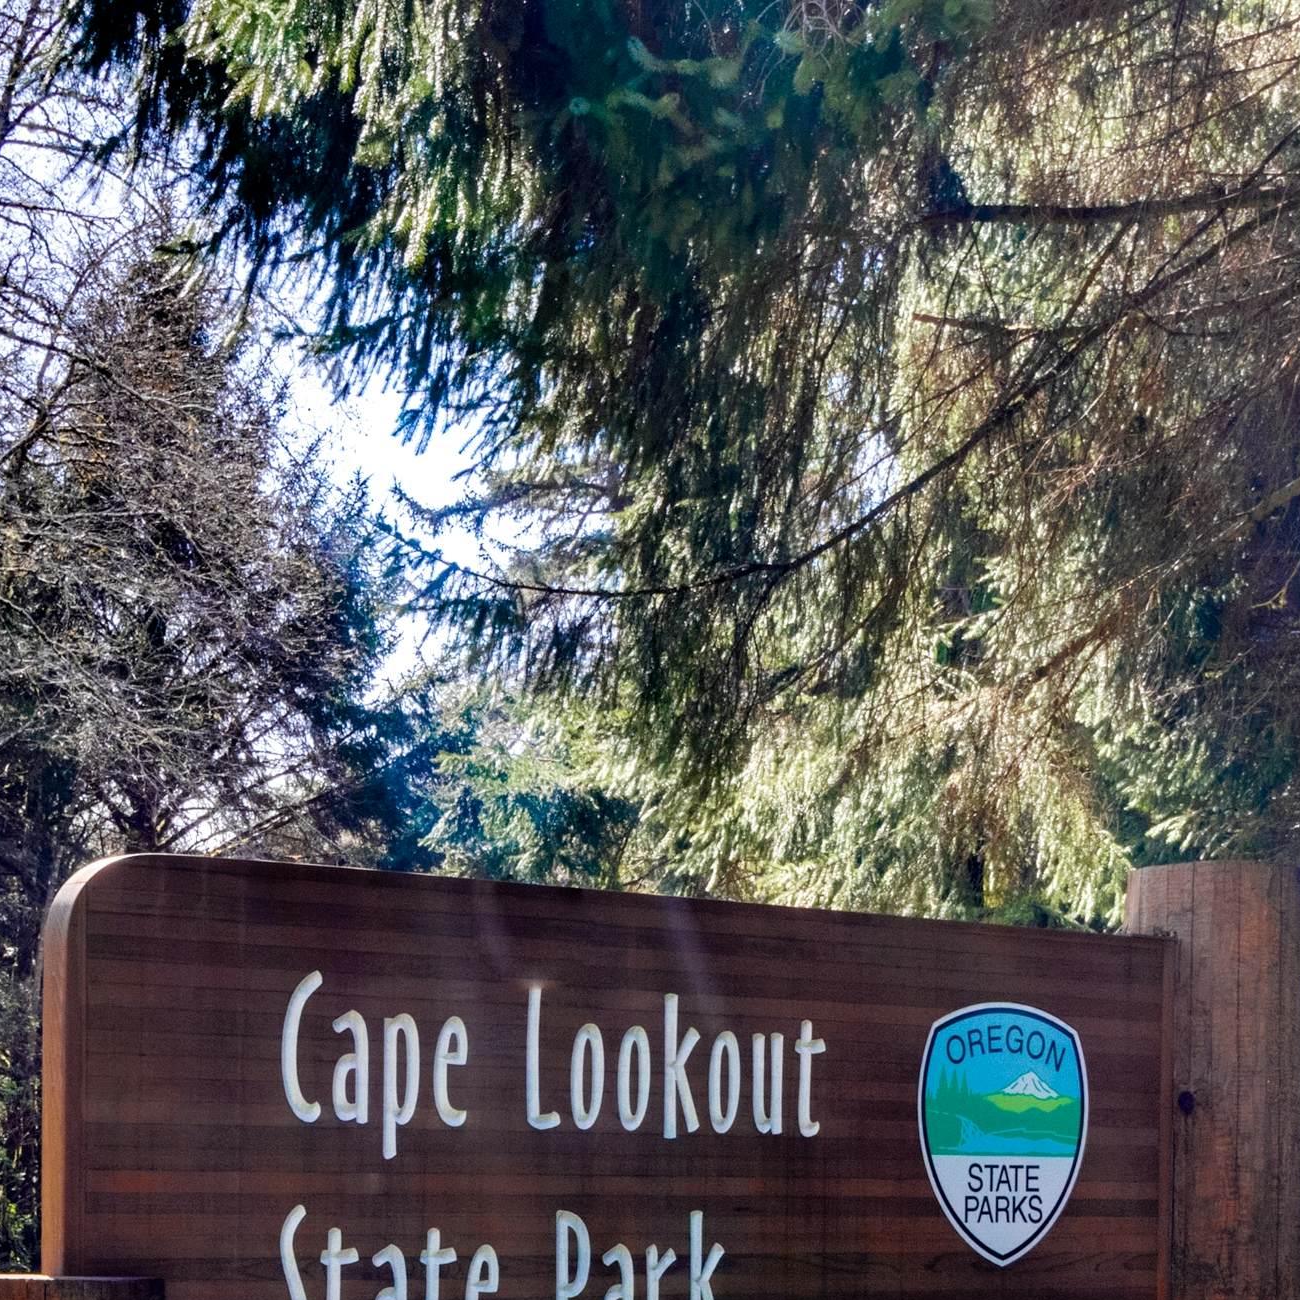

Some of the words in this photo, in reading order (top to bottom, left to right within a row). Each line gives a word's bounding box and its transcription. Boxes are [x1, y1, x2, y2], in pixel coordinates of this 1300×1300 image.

[281, 970, 469, 1160] Cape
[526, 987, 826, 1139] Lookout
[946, 1025, 1066, 1072] OREGON
[967, 1163, 1040, 1192] STATE
[964, 1195, 1043, 1224] PARKS
